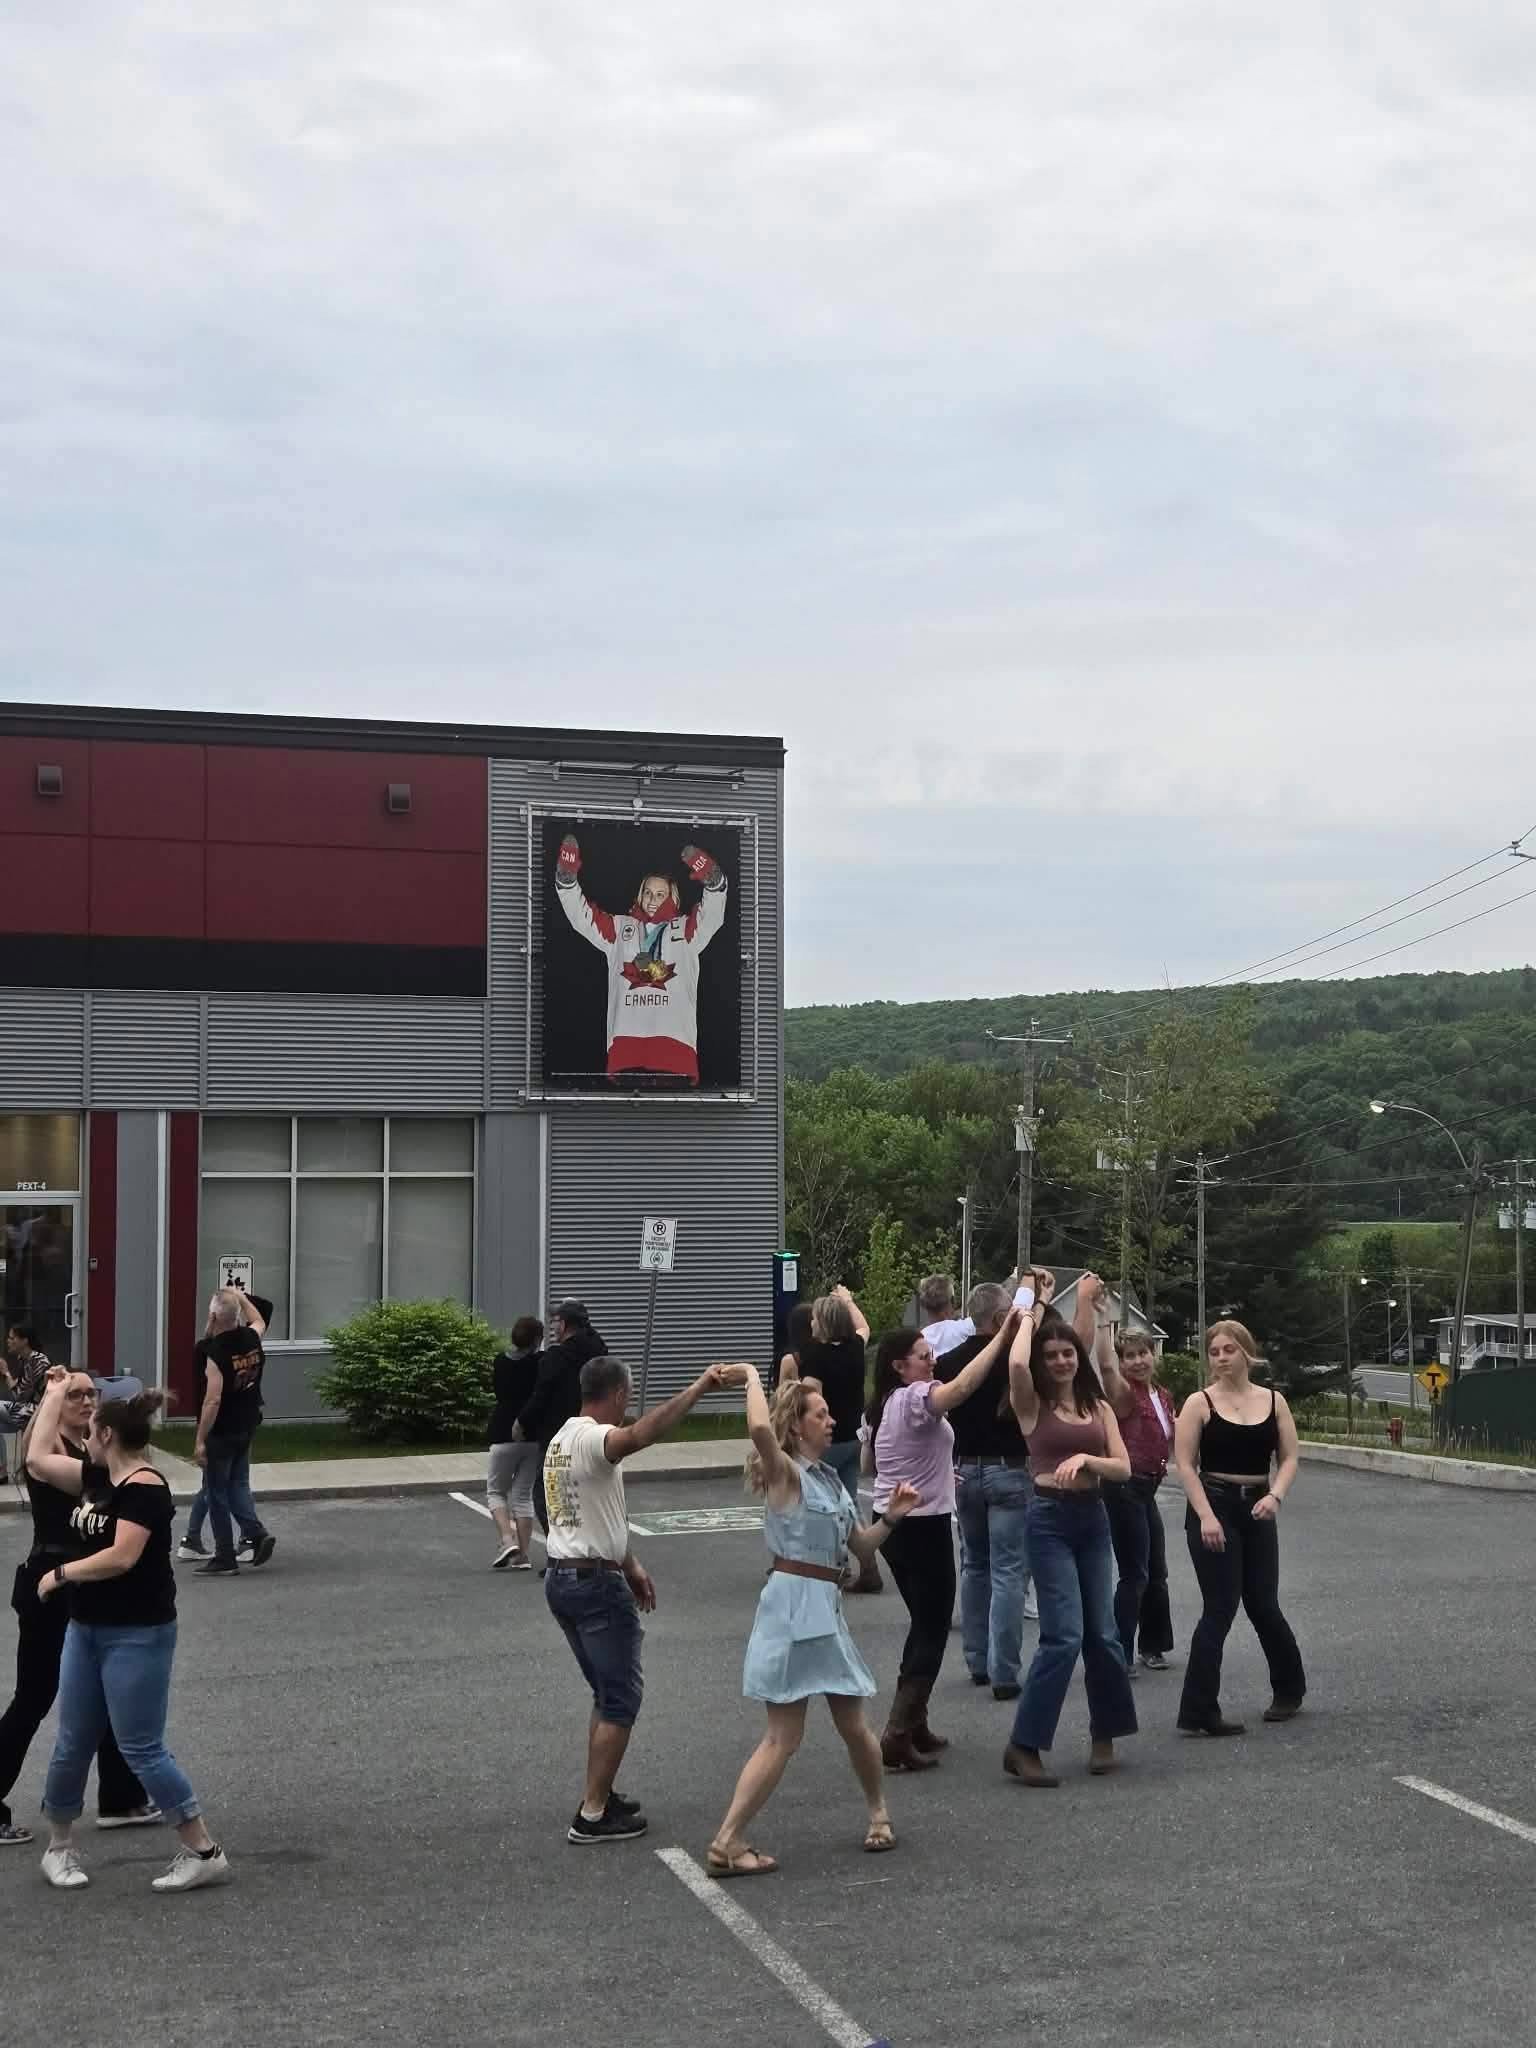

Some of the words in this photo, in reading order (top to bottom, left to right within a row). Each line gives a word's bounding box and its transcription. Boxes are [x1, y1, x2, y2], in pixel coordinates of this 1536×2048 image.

[561, 851, 576, 863] CAN
[625, 994, 669, 1007] CANADA
[17, 1182, 47, 1191] PEXT-4
